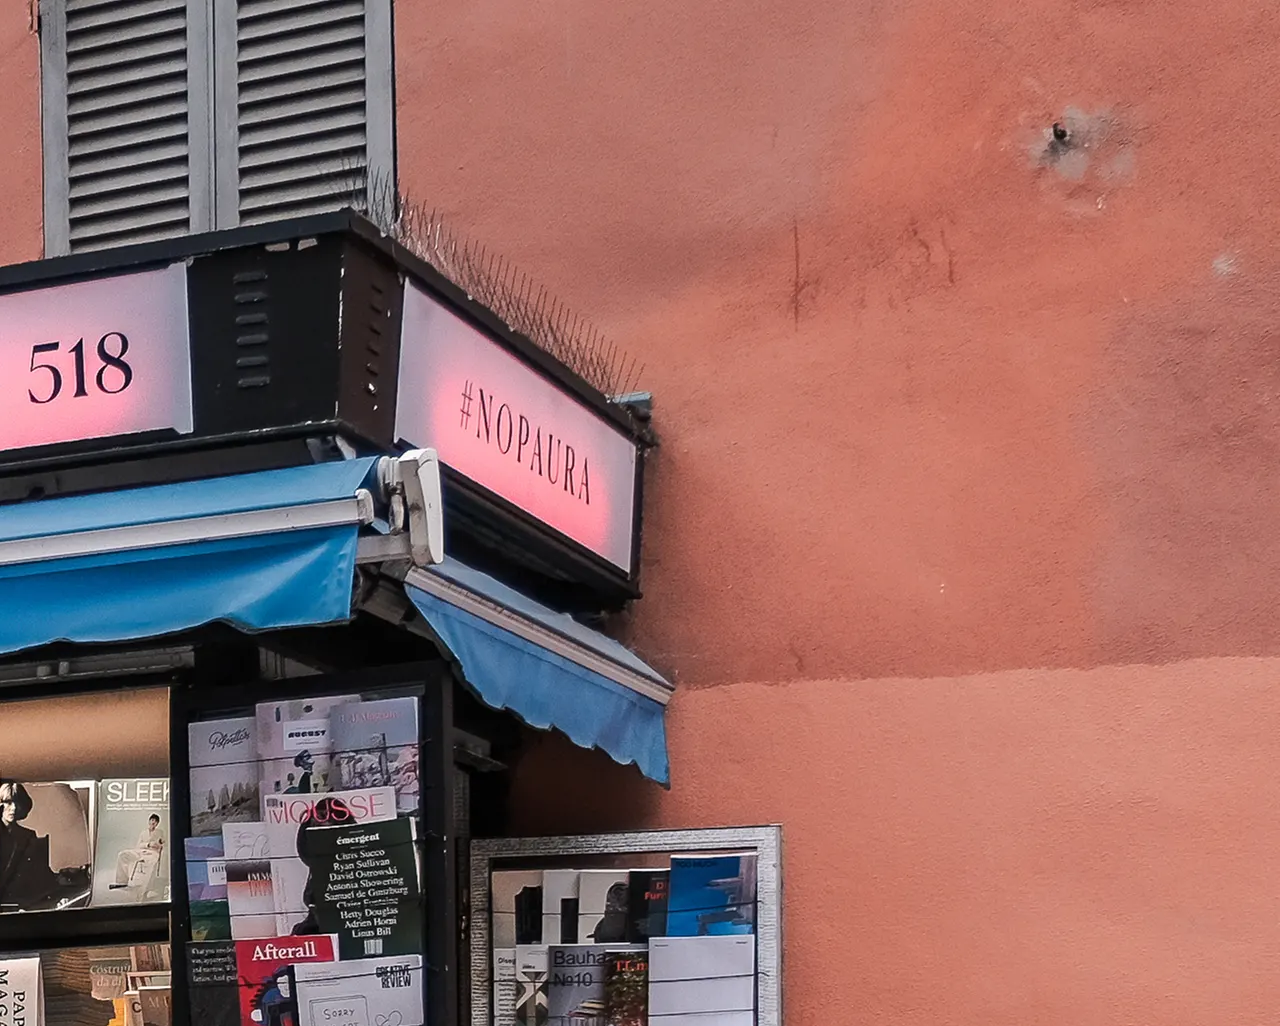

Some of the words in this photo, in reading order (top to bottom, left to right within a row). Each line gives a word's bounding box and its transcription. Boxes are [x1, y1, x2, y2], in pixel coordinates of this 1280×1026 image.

[28, 332, 132, 404] 518
[460, 380, 589, 505] #NOPAURA
[106, 780, 169, 803] SLEEK
[268, 792, 388, 825] MOUSSE
[336, 832, 380, 845] émergent
[333, 862, 355, 873] Ryan
[356, 858, 391, 869] Sullivan
[329, 871, 354, 882] David
[355, 866, 398, 879] Ostrowski
[324, 890, 354, 901] Samuel
[355, 889, 367, 898] de
[364, 906, 399, 917] Douglas
[376, 926, 392, 936] Bill
[251, 941, 318, 961] Afterall
[381, 975, 412, 988] REVIEW
